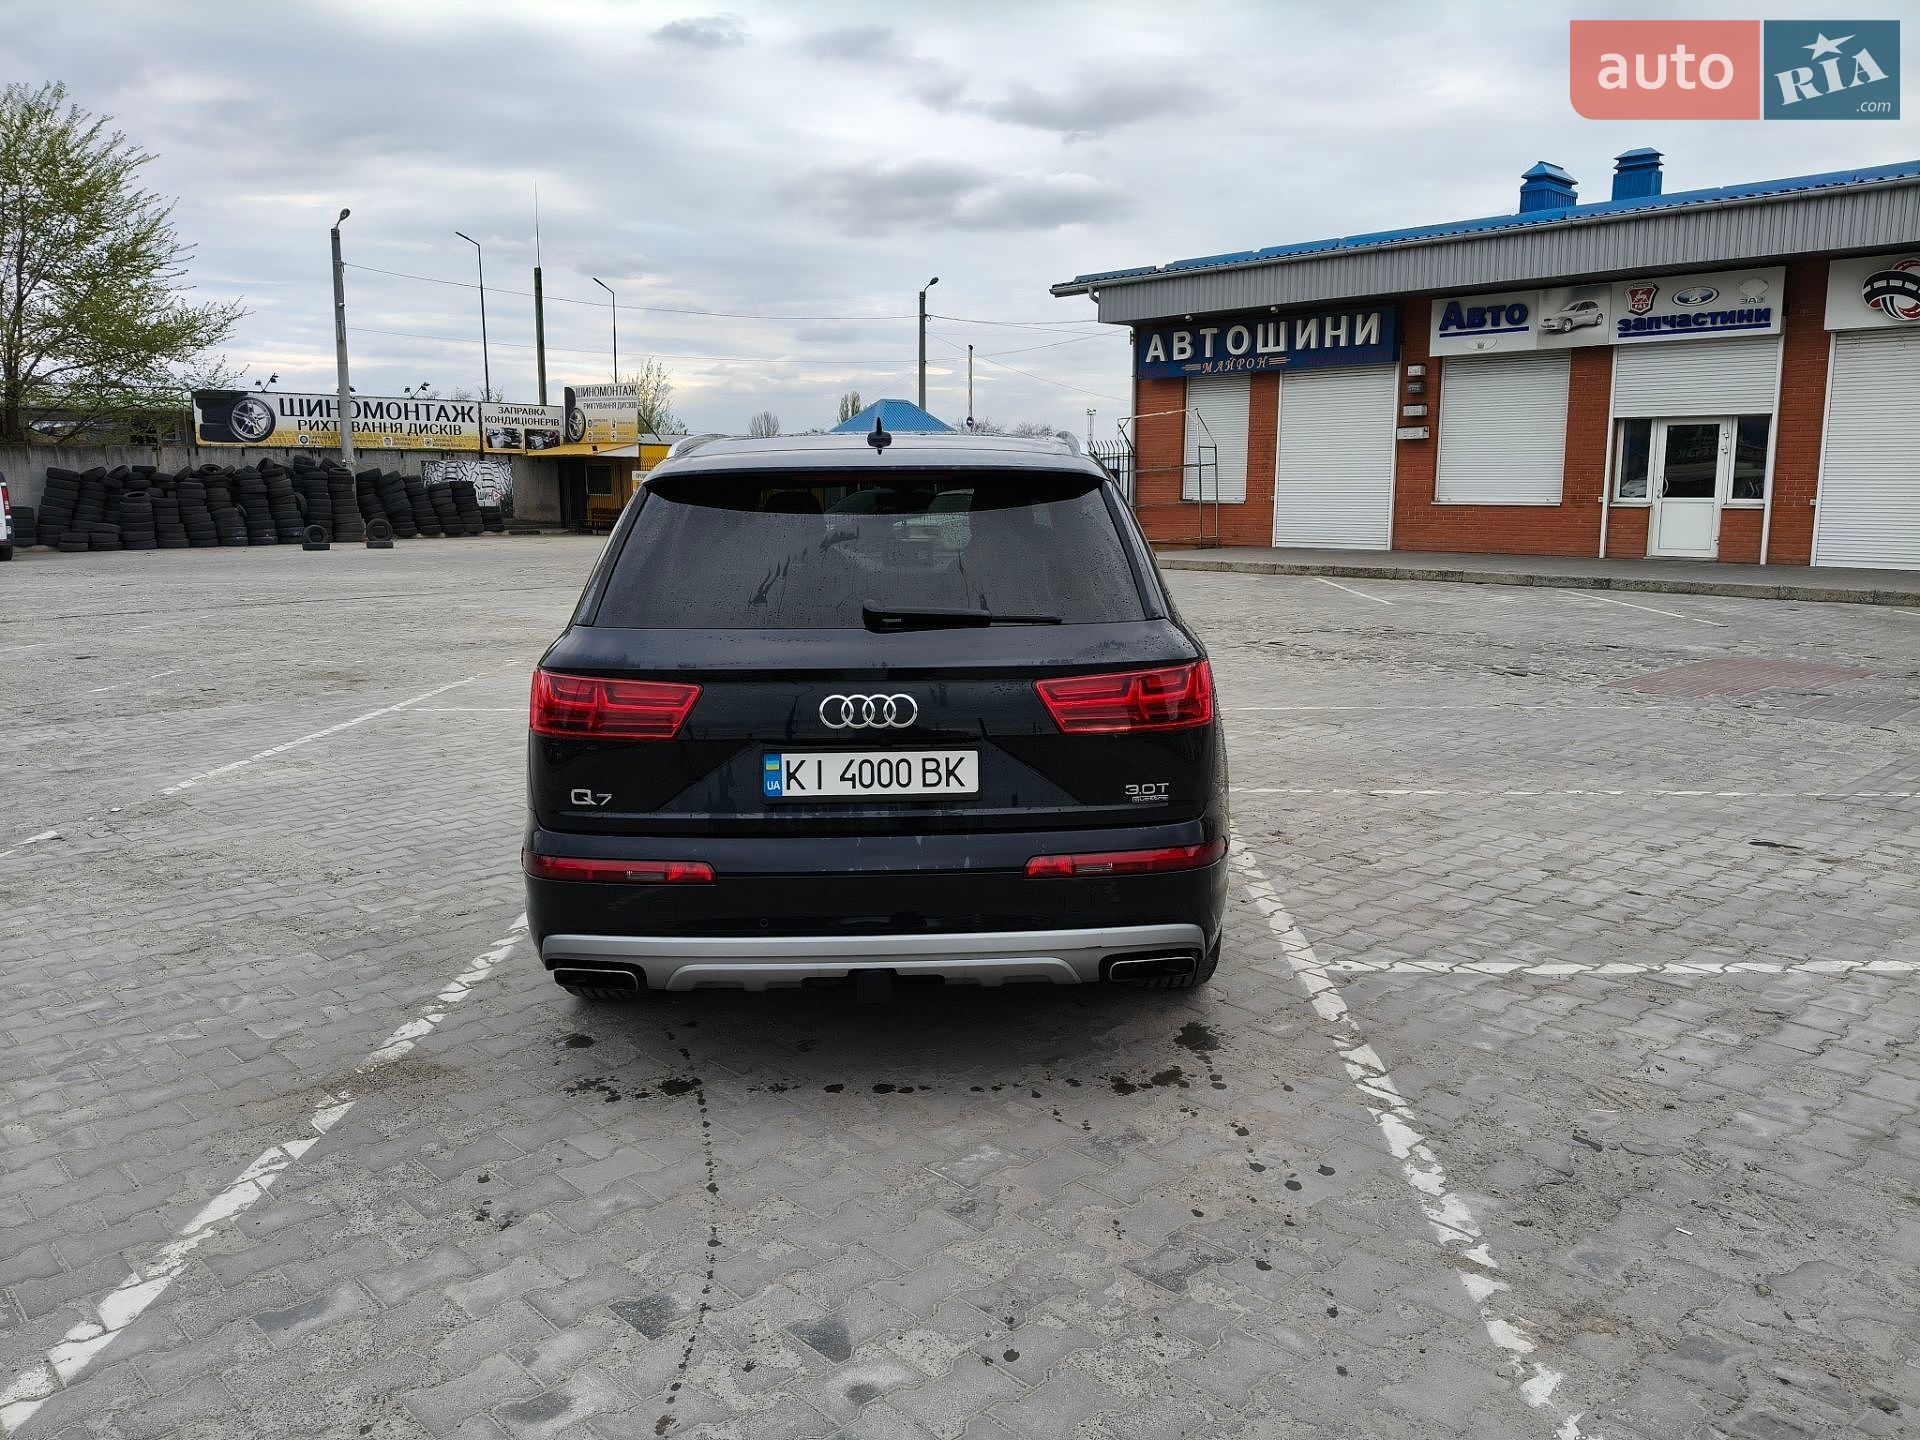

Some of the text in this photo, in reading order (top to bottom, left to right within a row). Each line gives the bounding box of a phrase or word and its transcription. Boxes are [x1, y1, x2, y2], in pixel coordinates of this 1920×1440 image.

[1617, 308, 1771, 332] запчастини
[1145, 312, 1381, 363] АВТОШИНИ
[1202, 355, 1269, 374] МАЙРОН
[575, 385, 637, 398] ШИНОМОНТАЖ
[279, 397, 475, 423] ШИНОМОНТАЖ
[498, 406, 546, 416] ЗАПРАВКА
[297, 419, 462, 436] РИХТВАННЯ ДИСКІВ
[484, 416, 560, 427] КОНДИЦІОНЕРІВ
[785, 757, 966, 790] KI 4000 BK
[767, 780, 781, 791] UA
[1125, 782, 1169, 795] 3.0T
[571, 789, 613, 806] Q7
